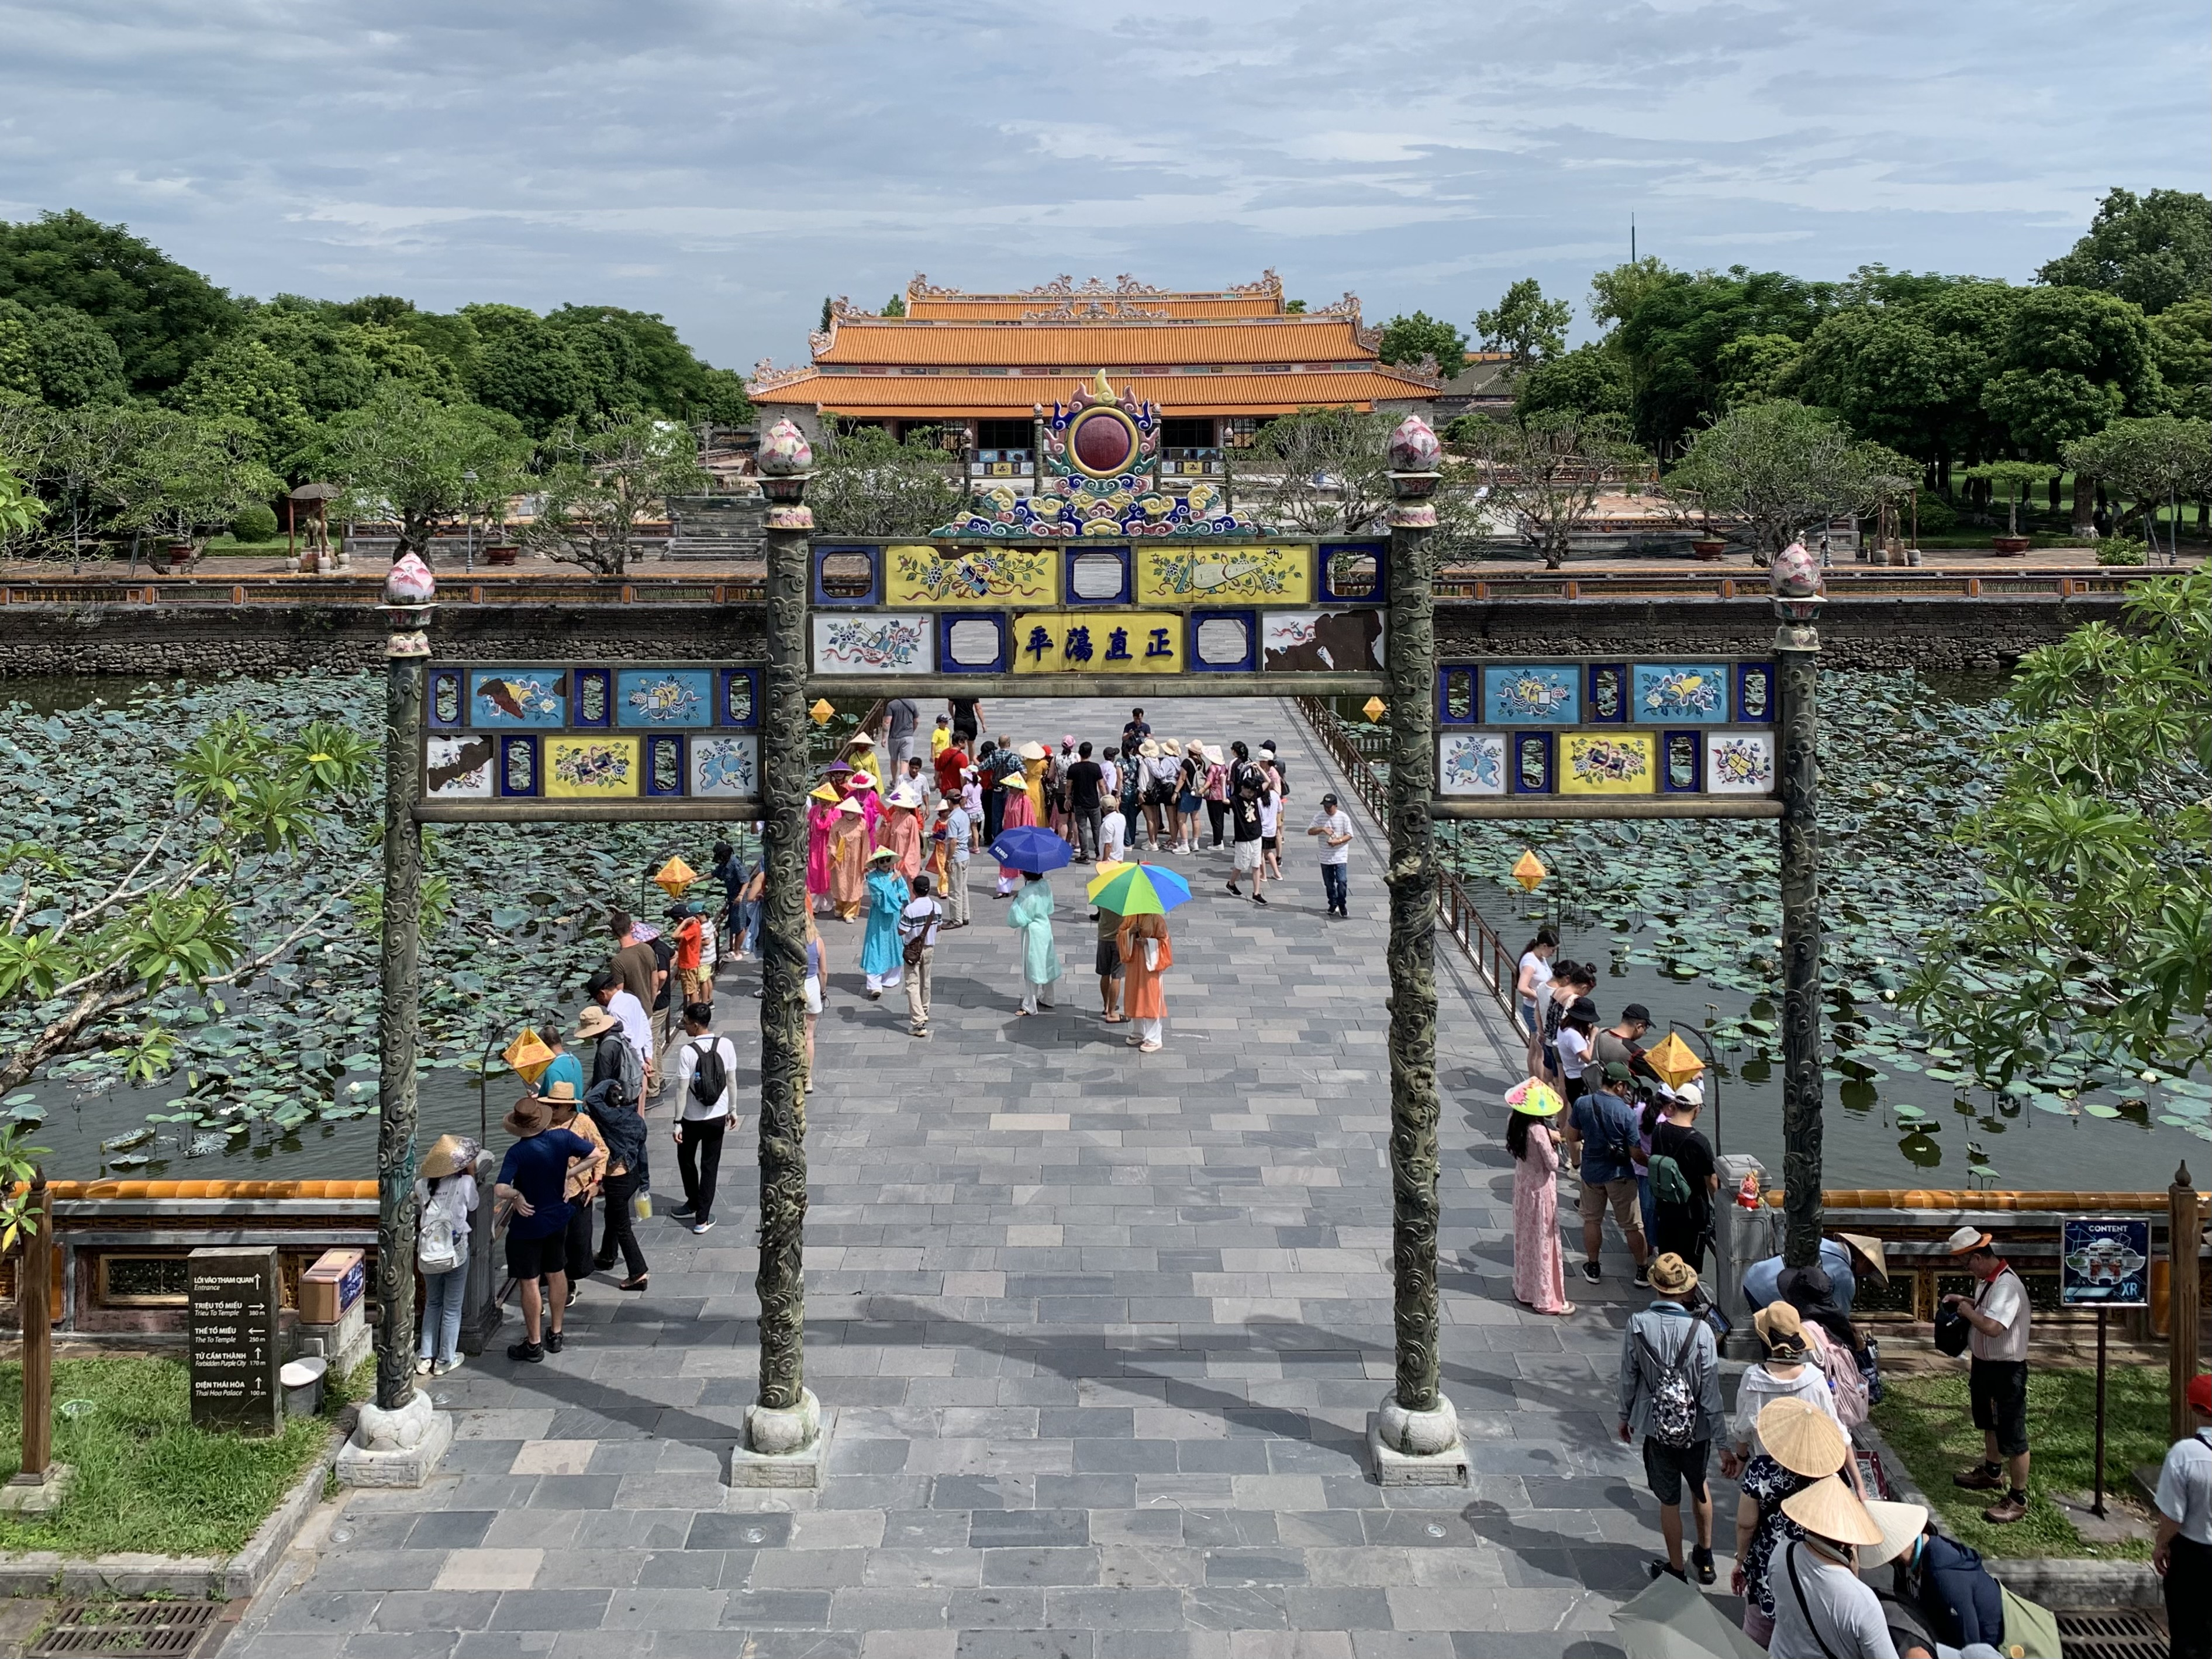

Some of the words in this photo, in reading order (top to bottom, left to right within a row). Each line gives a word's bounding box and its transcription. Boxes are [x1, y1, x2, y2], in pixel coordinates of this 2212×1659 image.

[2121, 1282, 2138, 1296] XR
[215, 1336, 236, 1344] Temple
[220, 1360, 236, 1368] Purple
[236, 1360, 247, 1368] City
